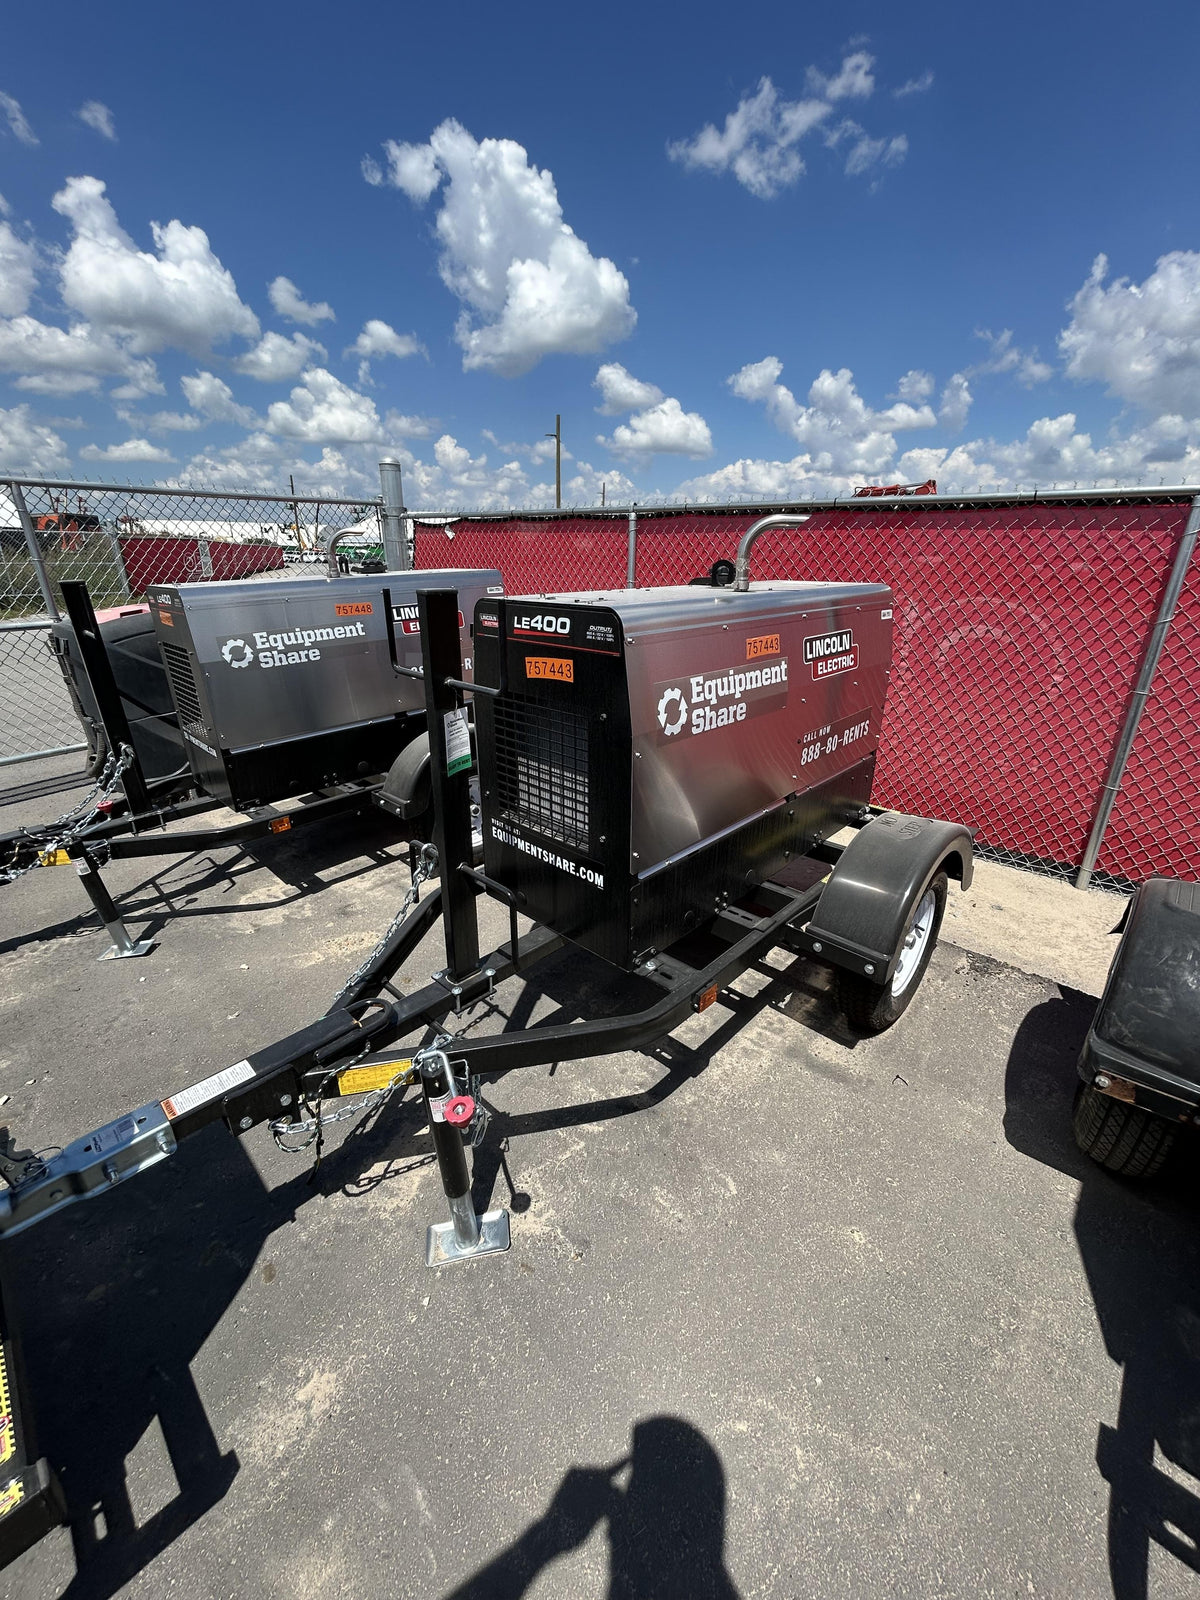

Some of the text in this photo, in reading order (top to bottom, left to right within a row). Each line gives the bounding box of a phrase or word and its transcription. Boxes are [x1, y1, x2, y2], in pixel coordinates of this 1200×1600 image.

[335, 603, 373, 615] 757448
[513, 614, 571, 634] LE400
[252, 621, 366, 650] Equipment
[806, 633, 851, 660] LINCOLN
[747, 637, 779, 657] 757443
[258, 648, 321, 669] Share
[526, 660, 572, 679] 757443
[817, 653, 855, 675] ELECTRIC
[690, 660, 788, 705] Equipment
[691, 702, 748, 735] Share
[800, 719, 870, 766] 888-80-RENTS
[803, 724, 832, 743] CALL NOW
[491, 825, 605, 888] EQUIPMENTSHARE.COM
